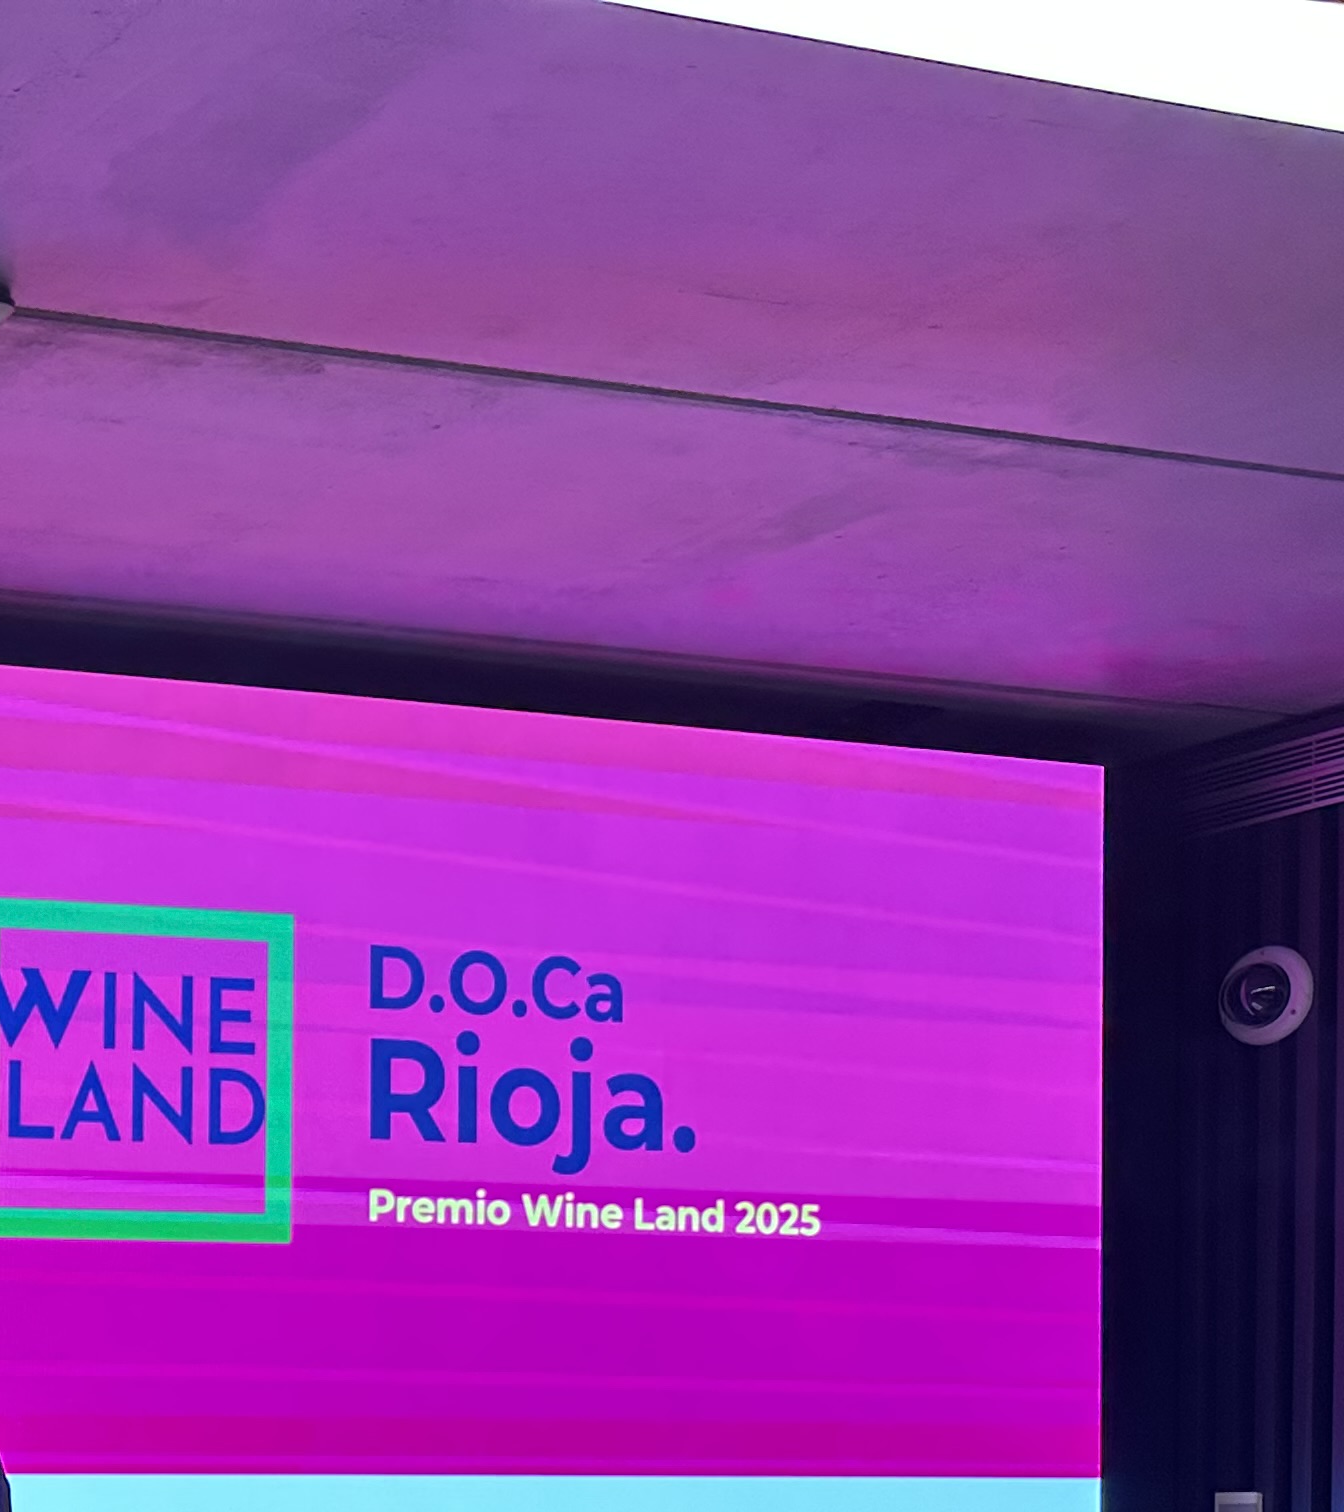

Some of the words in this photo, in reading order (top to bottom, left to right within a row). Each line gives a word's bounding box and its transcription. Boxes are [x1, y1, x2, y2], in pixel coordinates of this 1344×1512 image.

[369, 944, 623, 1023] D.O.Ca
[8, 1059, 266, 1145] LAND
[369, 1030, 696, 1176] Rioja.
[368, 1188, 510, 1227] Premio
[522, 1192, 623, 1231] Wine
[634, 1198, 725, 1233] Land
[735, 1202, 822, 1236] 2025
